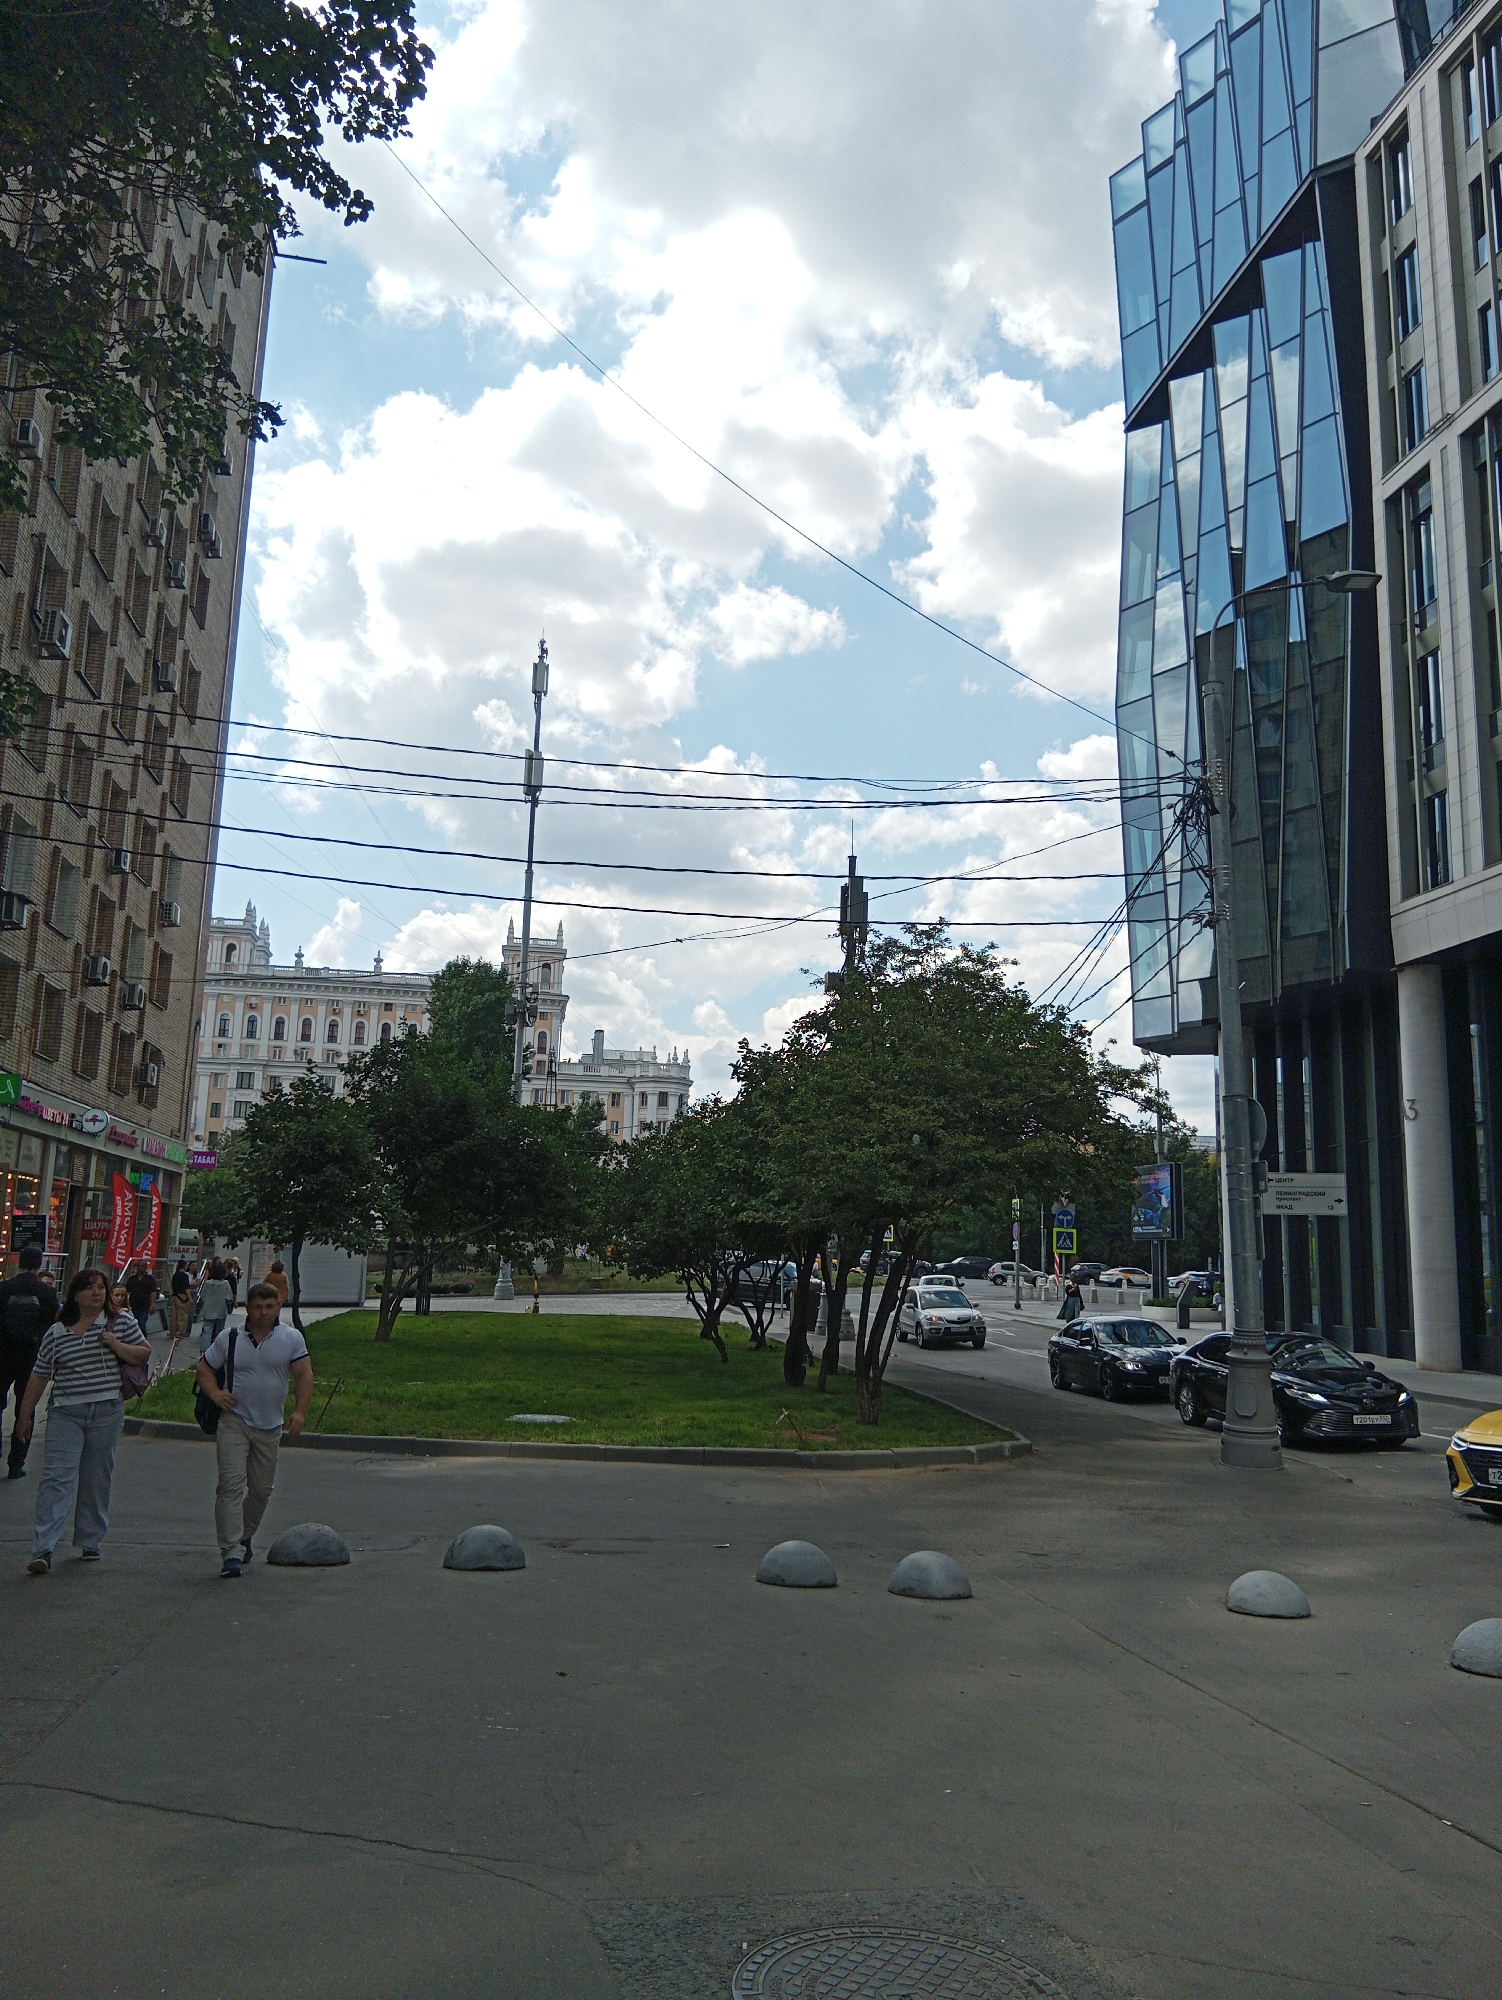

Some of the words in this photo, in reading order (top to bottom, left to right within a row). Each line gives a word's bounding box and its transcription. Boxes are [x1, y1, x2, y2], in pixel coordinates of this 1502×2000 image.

[43, 1107, 62, 1124] ЦВЕТЫ
[62, 1113, 70, 1127] 24
[194, 1155, 215, 1164] ТАБАК
[84, 1221, 112, 1229] ШАУРМ
